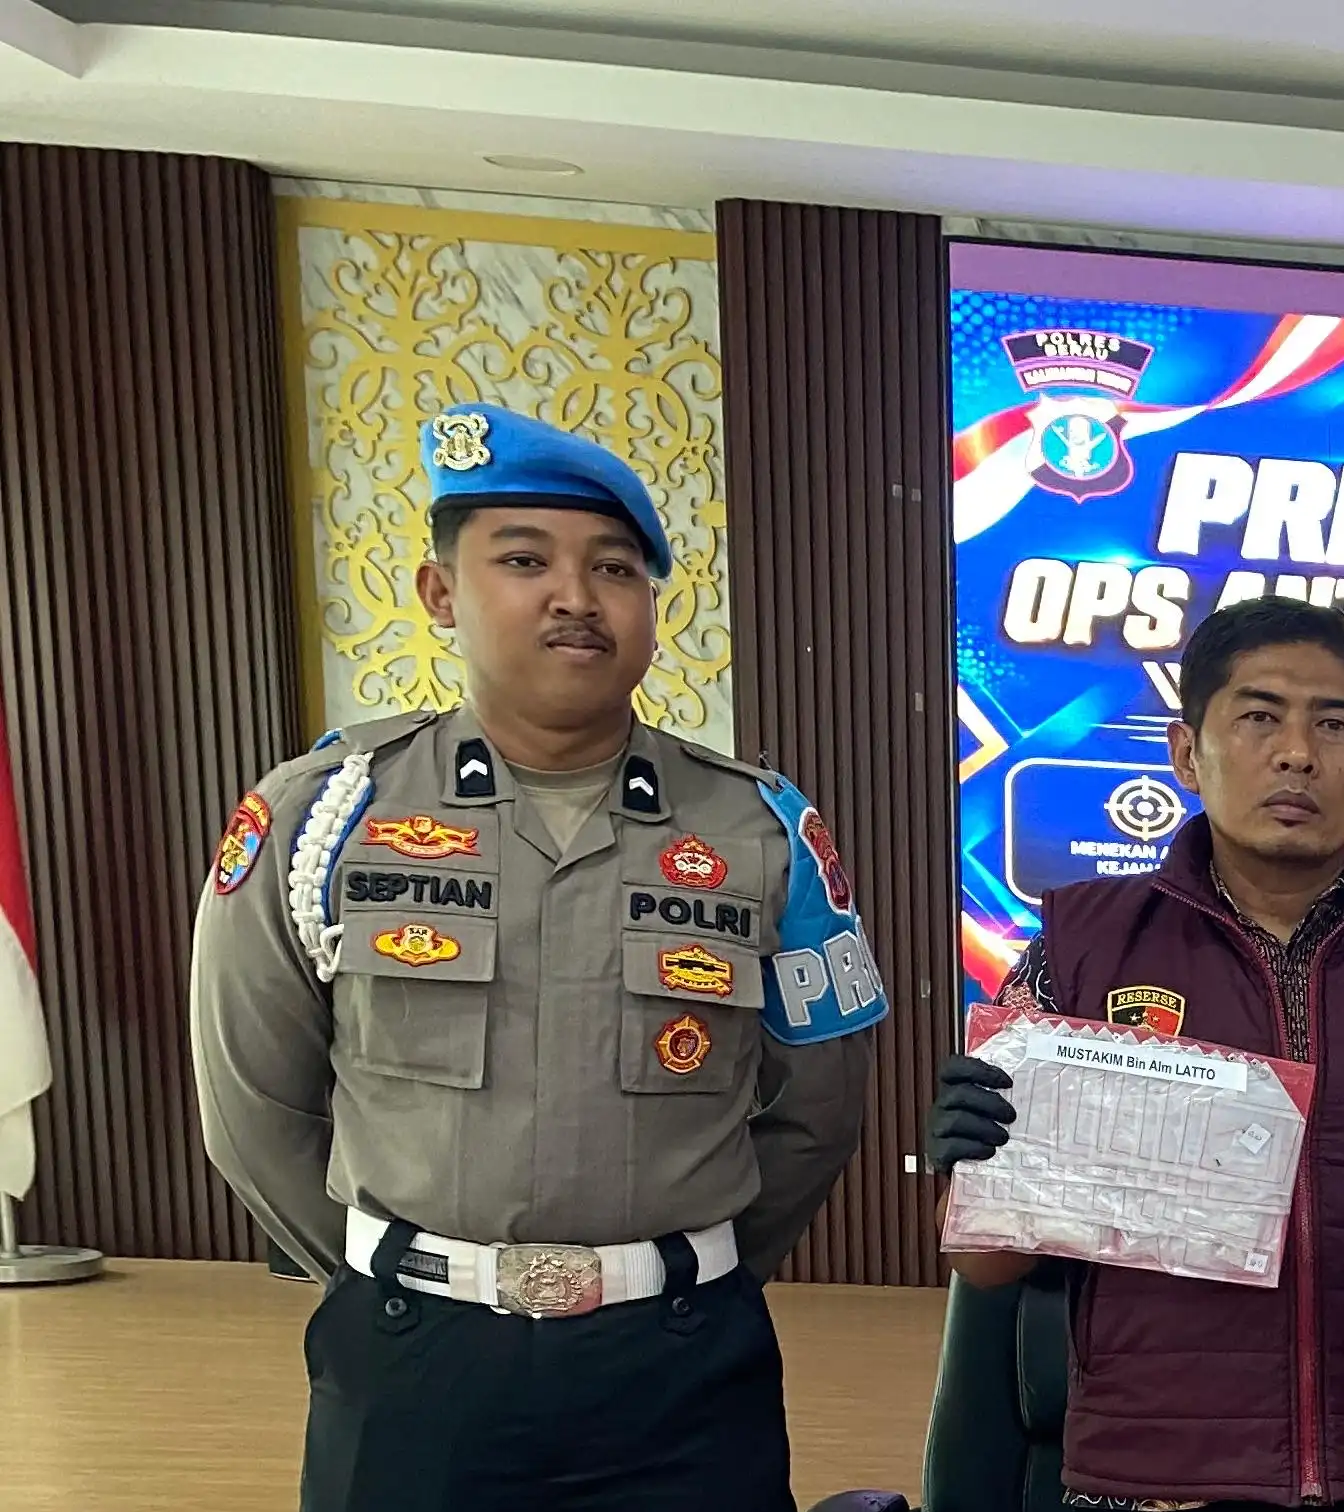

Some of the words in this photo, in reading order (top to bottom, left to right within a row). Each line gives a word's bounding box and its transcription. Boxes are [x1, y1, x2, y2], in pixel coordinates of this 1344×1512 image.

[1002, 557, 1190, 651] OPS
[1070, 840, 1157, 860] MENEKAN
[346, 870, 492, 909] SEPTIAN
[630, 891, 751, 938] POLRI
[1116, 989, 1178, 1010] RESERSE
[1056, 1044, 1124, 1068] MUSTAKIM
[1126, 1055, 1146, 1071] Bin
[1148, 1058, 1173, 1075] Alm
[1174, 1063, 1217, 1082] LATTO
